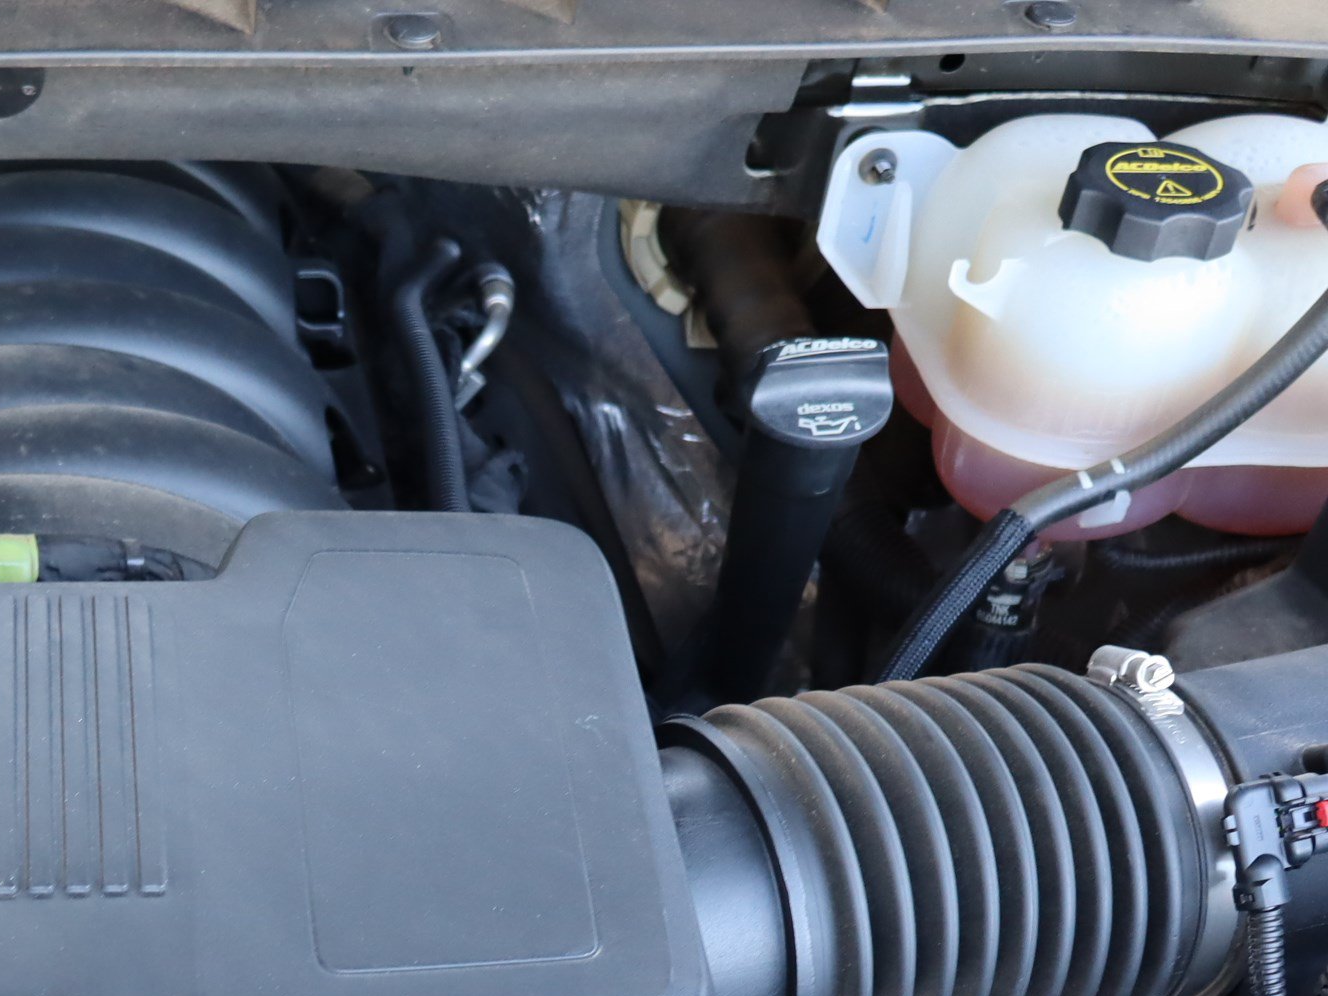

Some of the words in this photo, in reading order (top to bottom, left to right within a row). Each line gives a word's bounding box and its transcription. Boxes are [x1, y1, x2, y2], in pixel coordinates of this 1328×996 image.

[1112, 161, 1209, 172] ACDelco
[778, 338, 878, 357] ACDelco
[797, 403, 854, 416] dexos
